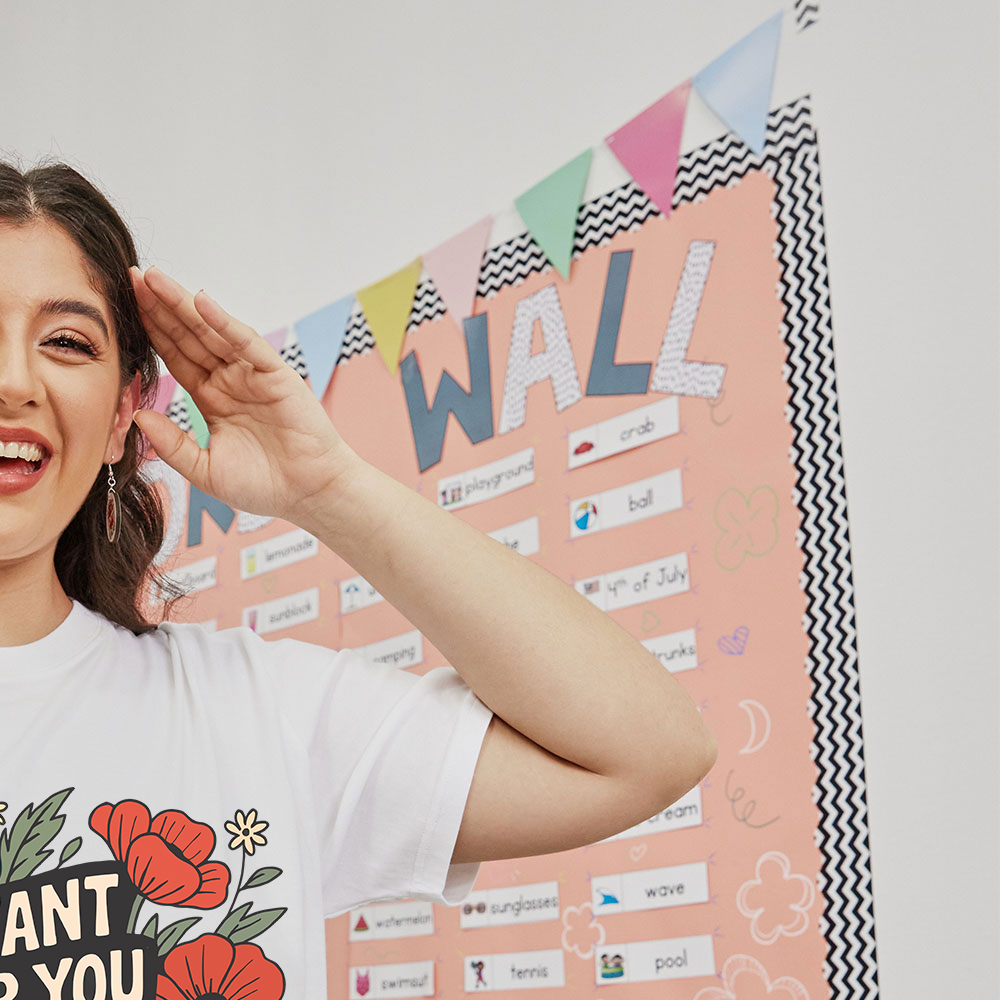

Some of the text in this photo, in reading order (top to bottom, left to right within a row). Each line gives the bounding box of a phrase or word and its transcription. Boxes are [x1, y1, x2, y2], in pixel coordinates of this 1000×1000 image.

[400, 240, 727, 473] WALL
[620, 415, 655, 441] crab
[465, 453, 534, 497] playground
[628, 488, 653, 512] ball
[265, 537, 314, 562] lemonade
[633, 572, 650, 593] of
[656, 564, 688, 586] July
[652, 642, 696, 661] runks
[644, 882, 685, 898] wave
[490, 893, 559, 917] sunglasses
[375, 912, 432, 929] watermelon
[511, 965, 549, 981] tennis
[655, 948, 689, 974] pool
[381, 974, 428, 990] swimsuit
